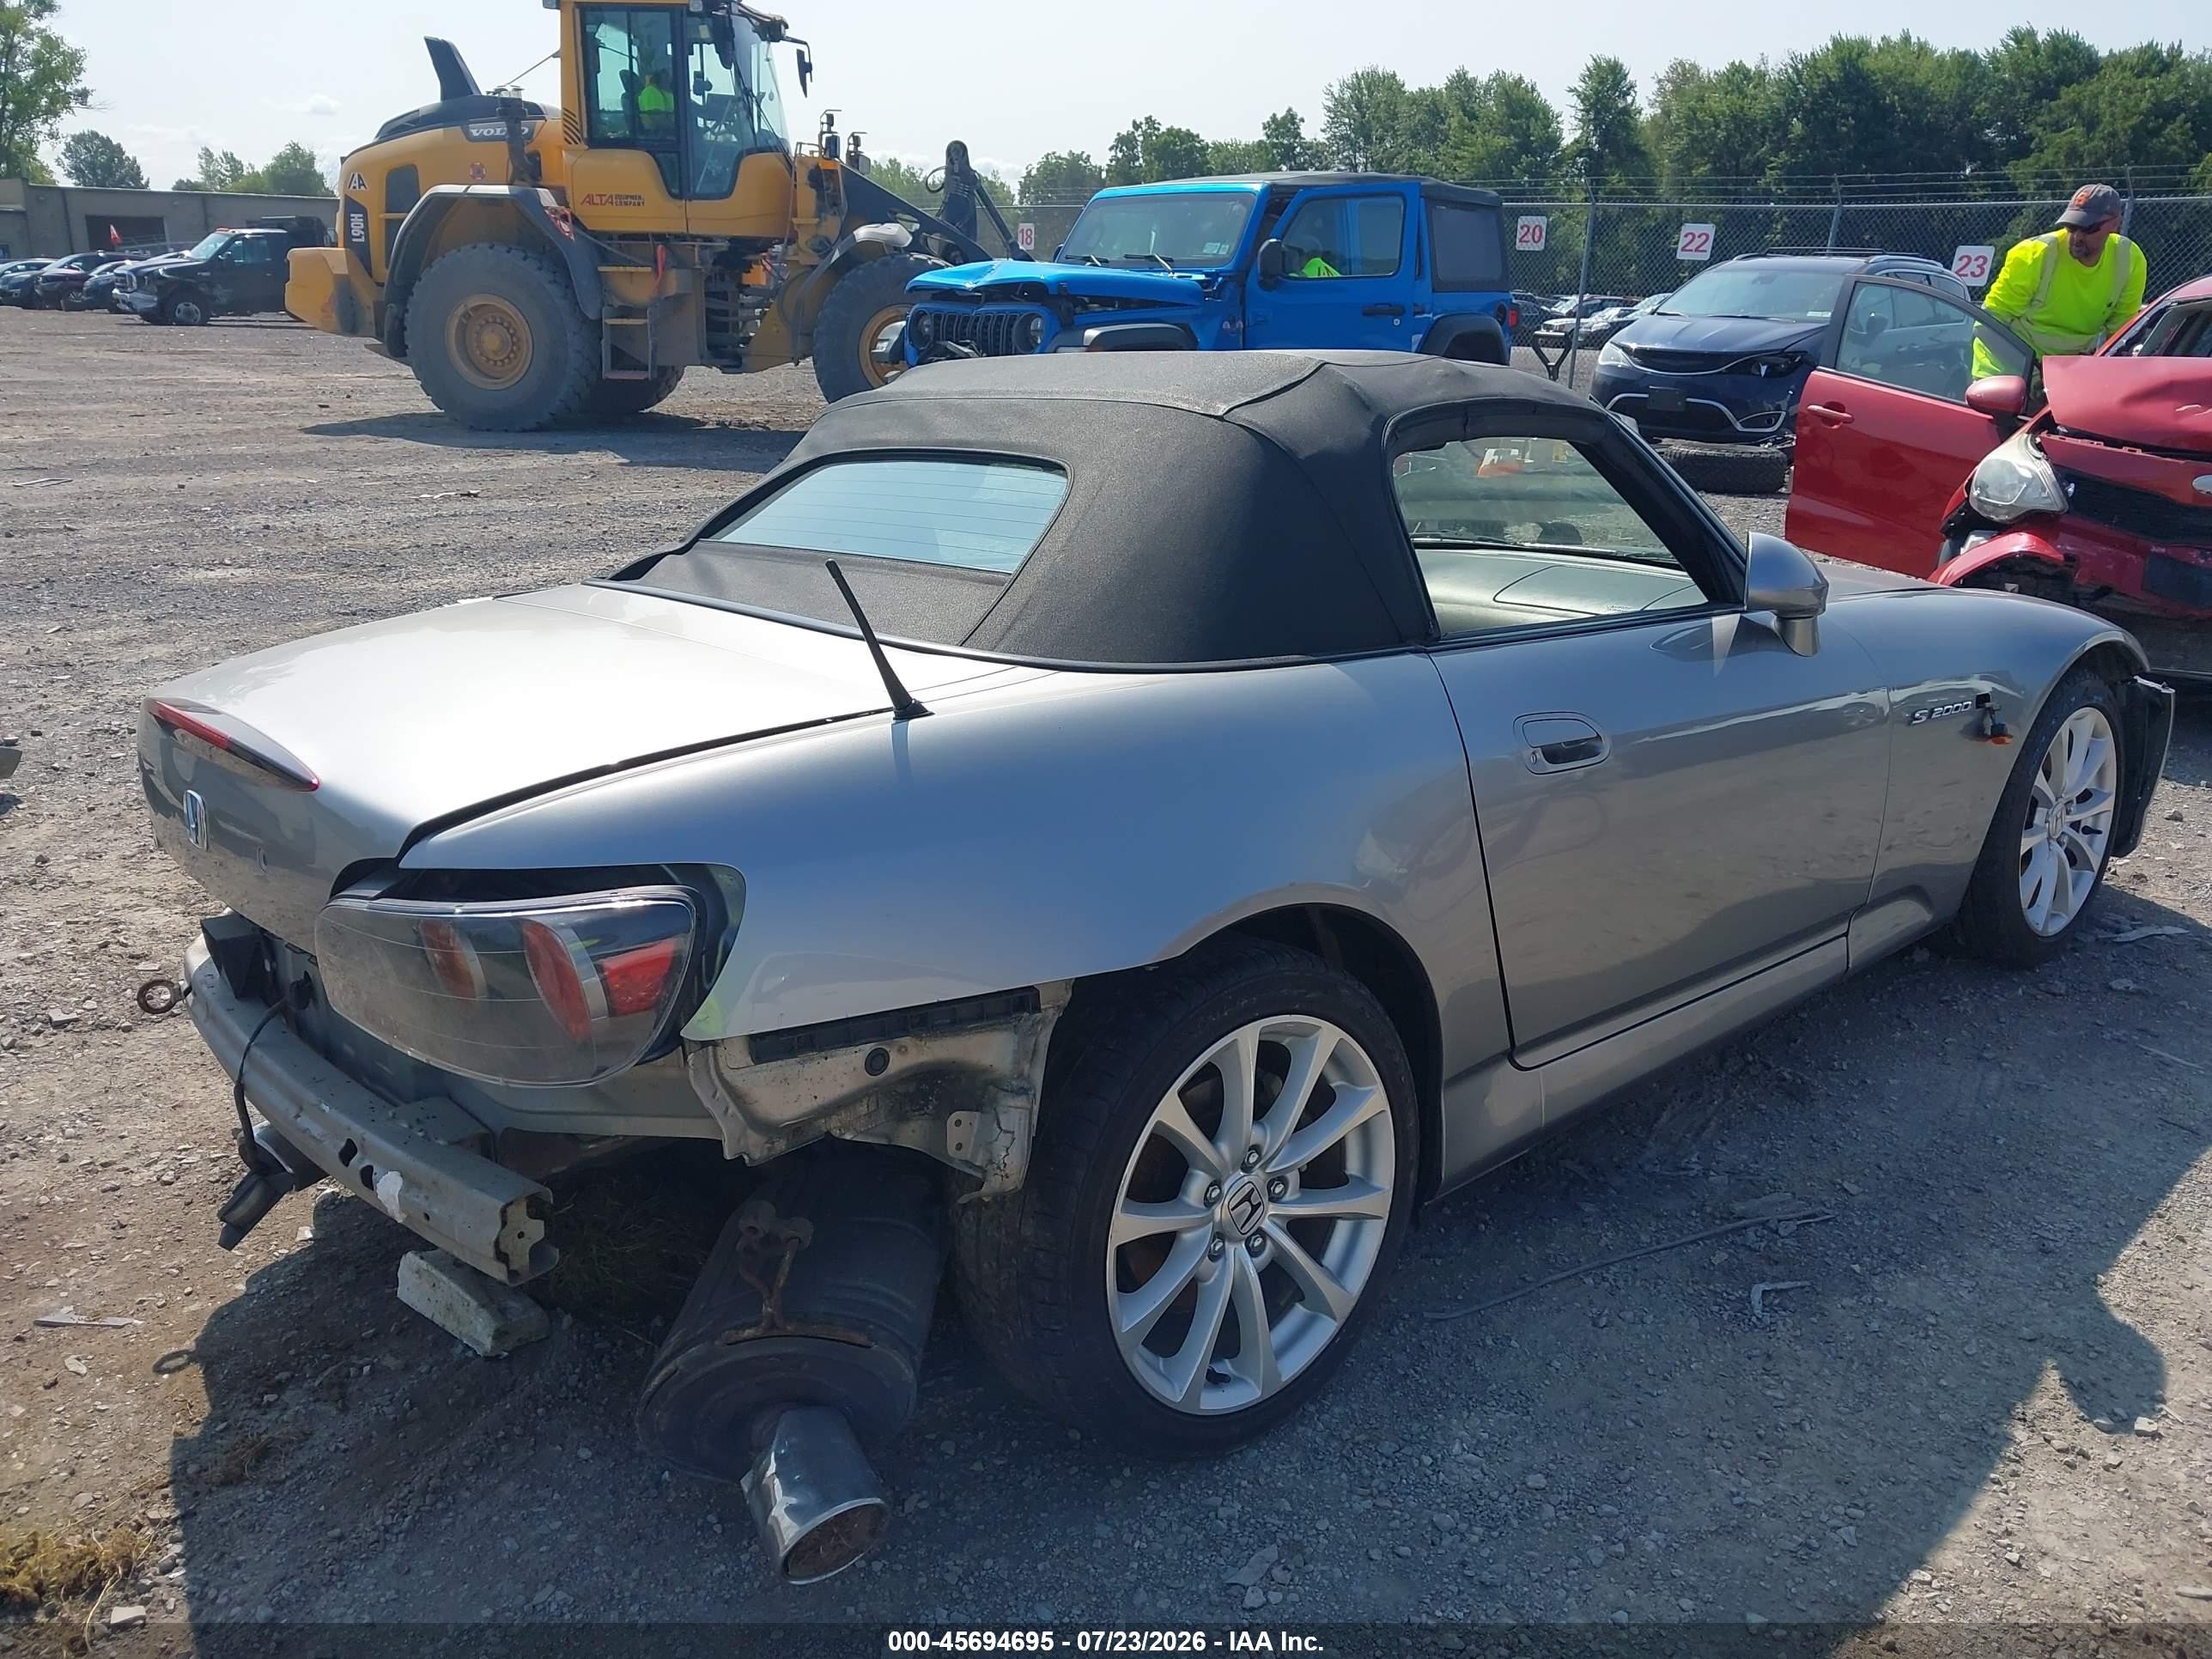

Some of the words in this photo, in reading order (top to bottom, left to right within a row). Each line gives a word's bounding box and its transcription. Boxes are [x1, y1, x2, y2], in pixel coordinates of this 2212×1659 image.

[469, 126, 529, 137] VOLO
[580, 193, 614, 206] ALTA
[349, 213, 365, 242] L90H
[1019, 228, 1033, 246] 18
[1518, 224, 1543, 244] 20
[1680, 232, 1711, 252] 22
[1954, 254, 1989, 278] 23
